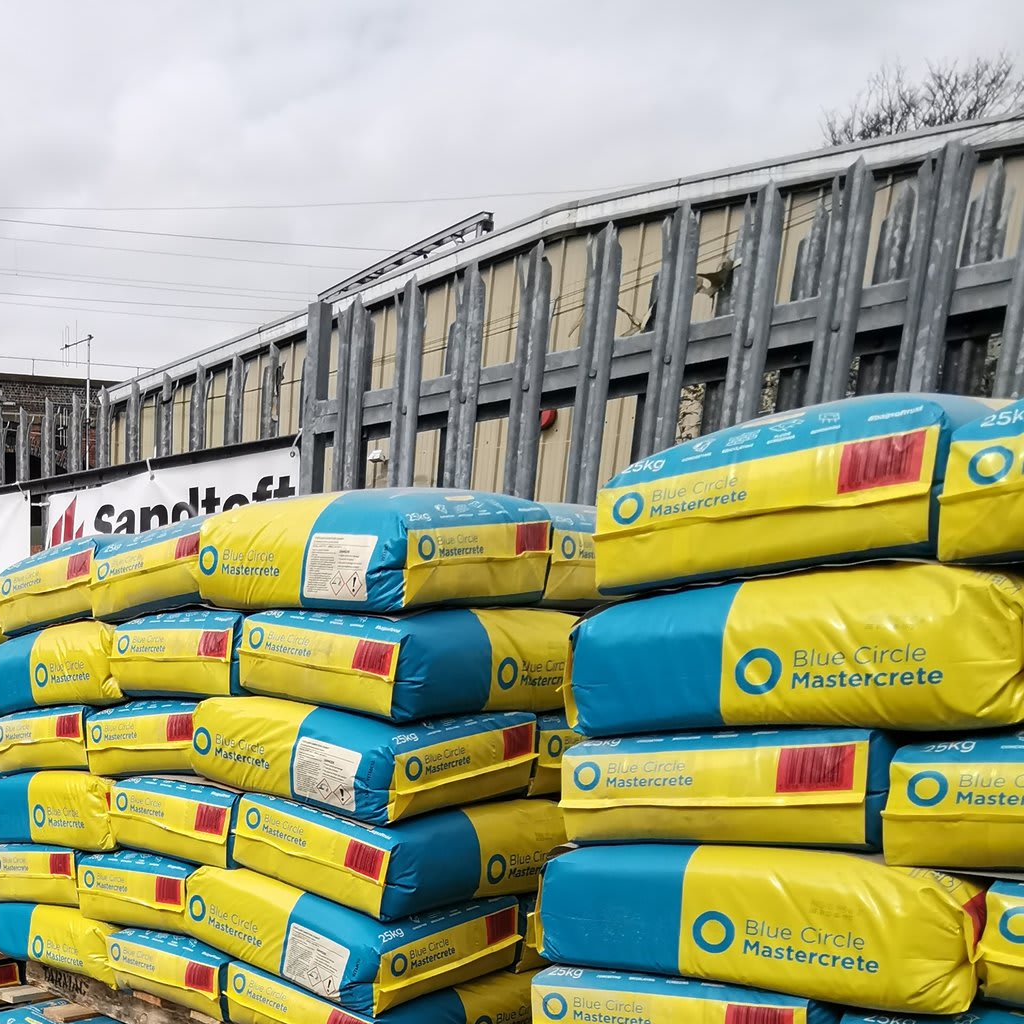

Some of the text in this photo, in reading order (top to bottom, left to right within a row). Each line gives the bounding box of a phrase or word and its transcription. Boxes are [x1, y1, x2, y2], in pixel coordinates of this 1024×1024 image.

[623, 458, 665, 474] 25kg
[652, 475, 739, 501] Blue Circle
[649, 489, 747, 517] Mastercrete
[437, 533, 479, 546] Blue Circle
[222, 548, 275, 563] Blue Circle
[438, 543, 484, 557] Mastercrete
[221, 563, 281, 577] Mastercrete
[267, 631, 310, 646] Blue Circle
[264, 642, 312, 658] Mastercrete
[793, 644, 927, 667] Blue Circle
[791, 667, 944, 689] Mastercrete
[214, 733, 265, 755] Blue Circle
[392, 731, 419, 744] 25kg
[214, 748, 270, 770] Mastercrete
[424, 746, 466, 764] Blue Circle
[425, 755, 471, 775] Mastercrete
[607, 760, 686, 774] Blue Circle
[606, 773, 694, 789] Mastercrete
[959, 773, 1006, 789] Blue
[209, 904, 259, 933] Blue Circle
[207, 917, 263, 948] Mastercrete
[378, 928, 405, 942] 25kg
[745, 919, 865, 951] Blue Circle
[409, 938, 449, 959] Blue Circle
[411, 947, 456, 968] Mastercrete
[742, 939, 880, 974] Mastercrete
[548, 966, 583, 980] 25kg
[573, 996, 643, 1015] Blue Circle
